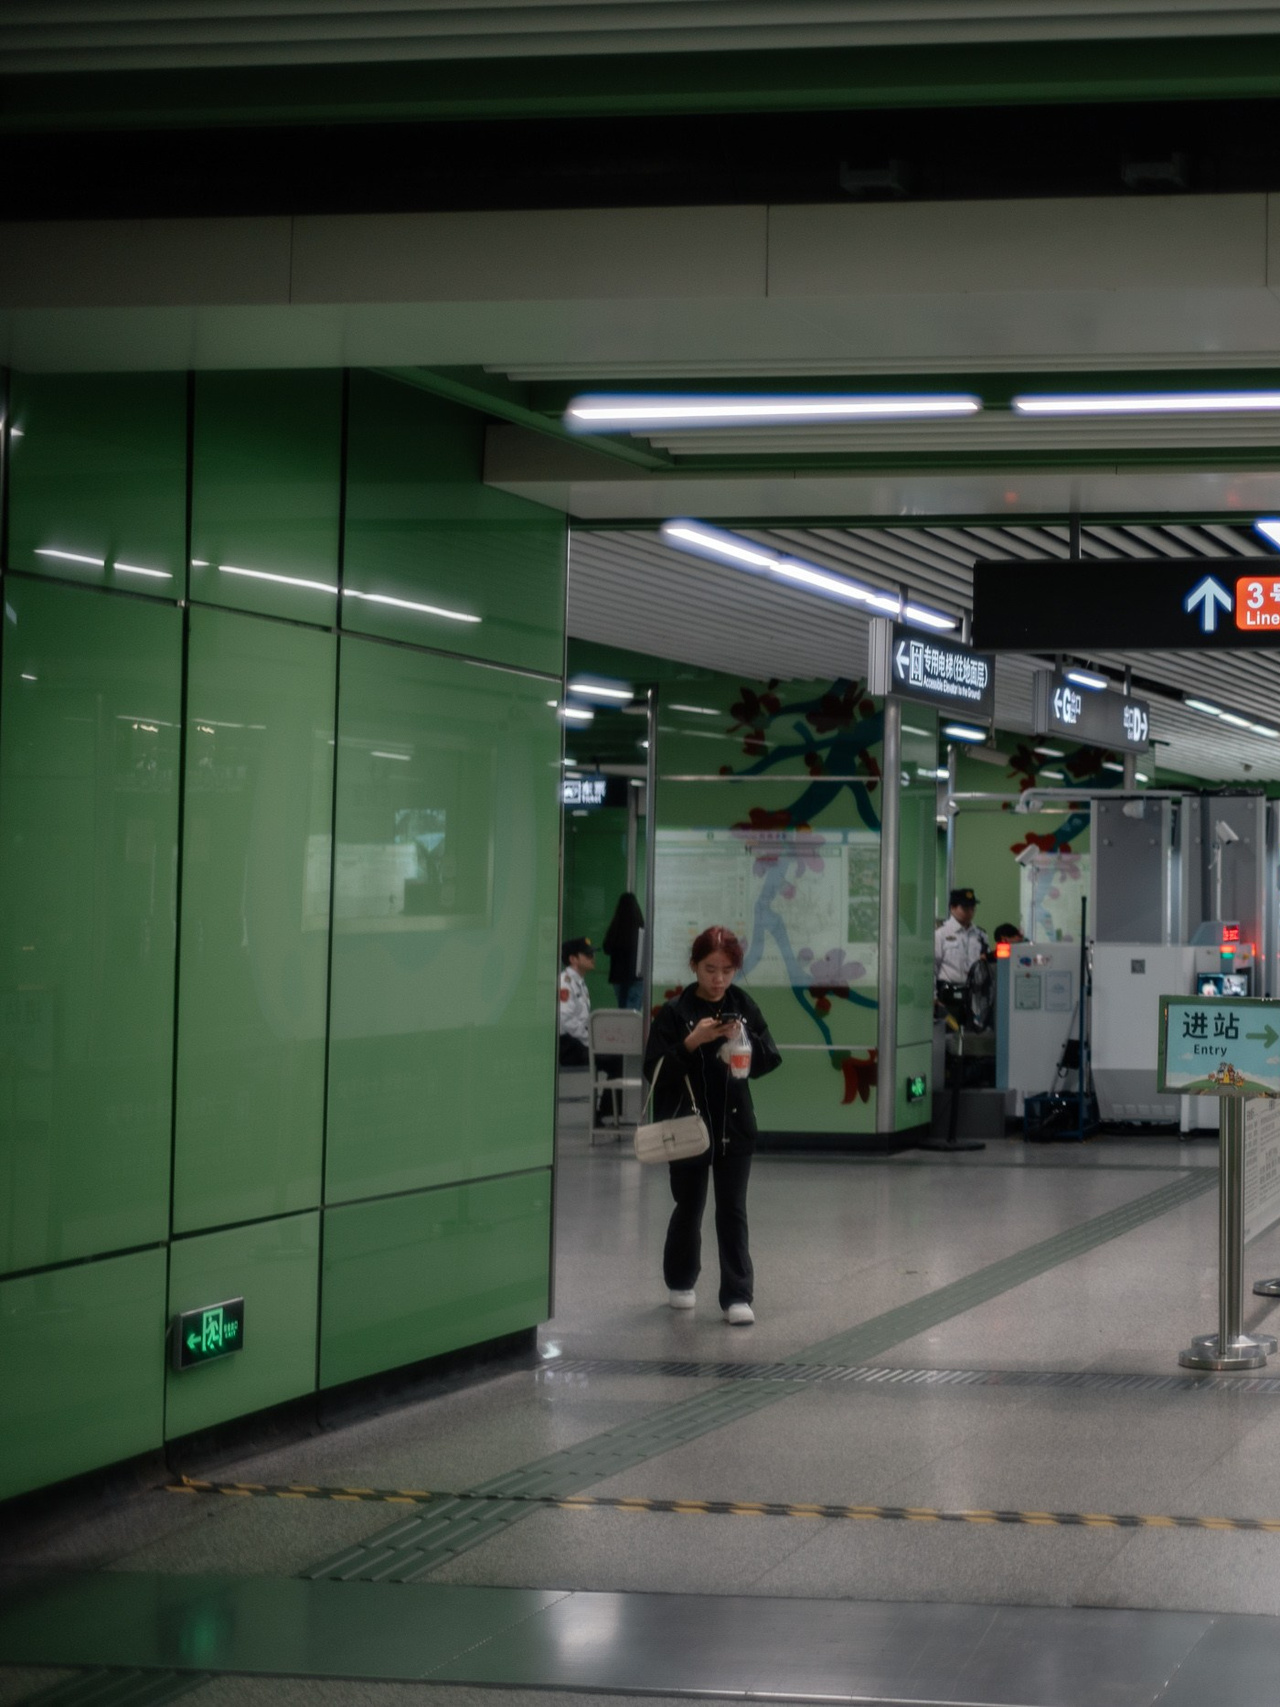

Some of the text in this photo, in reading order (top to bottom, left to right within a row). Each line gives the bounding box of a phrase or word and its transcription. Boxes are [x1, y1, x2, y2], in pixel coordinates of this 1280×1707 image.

[924, 645, 988, 689] 专用电梯(往地面层)
[1063, 688, 1071, 723] G
[1133, 707, 1141, 741] D
[1182, 1012, 1240, 1039] 进站
[1194, 1044, 1227, 1056] Entry
